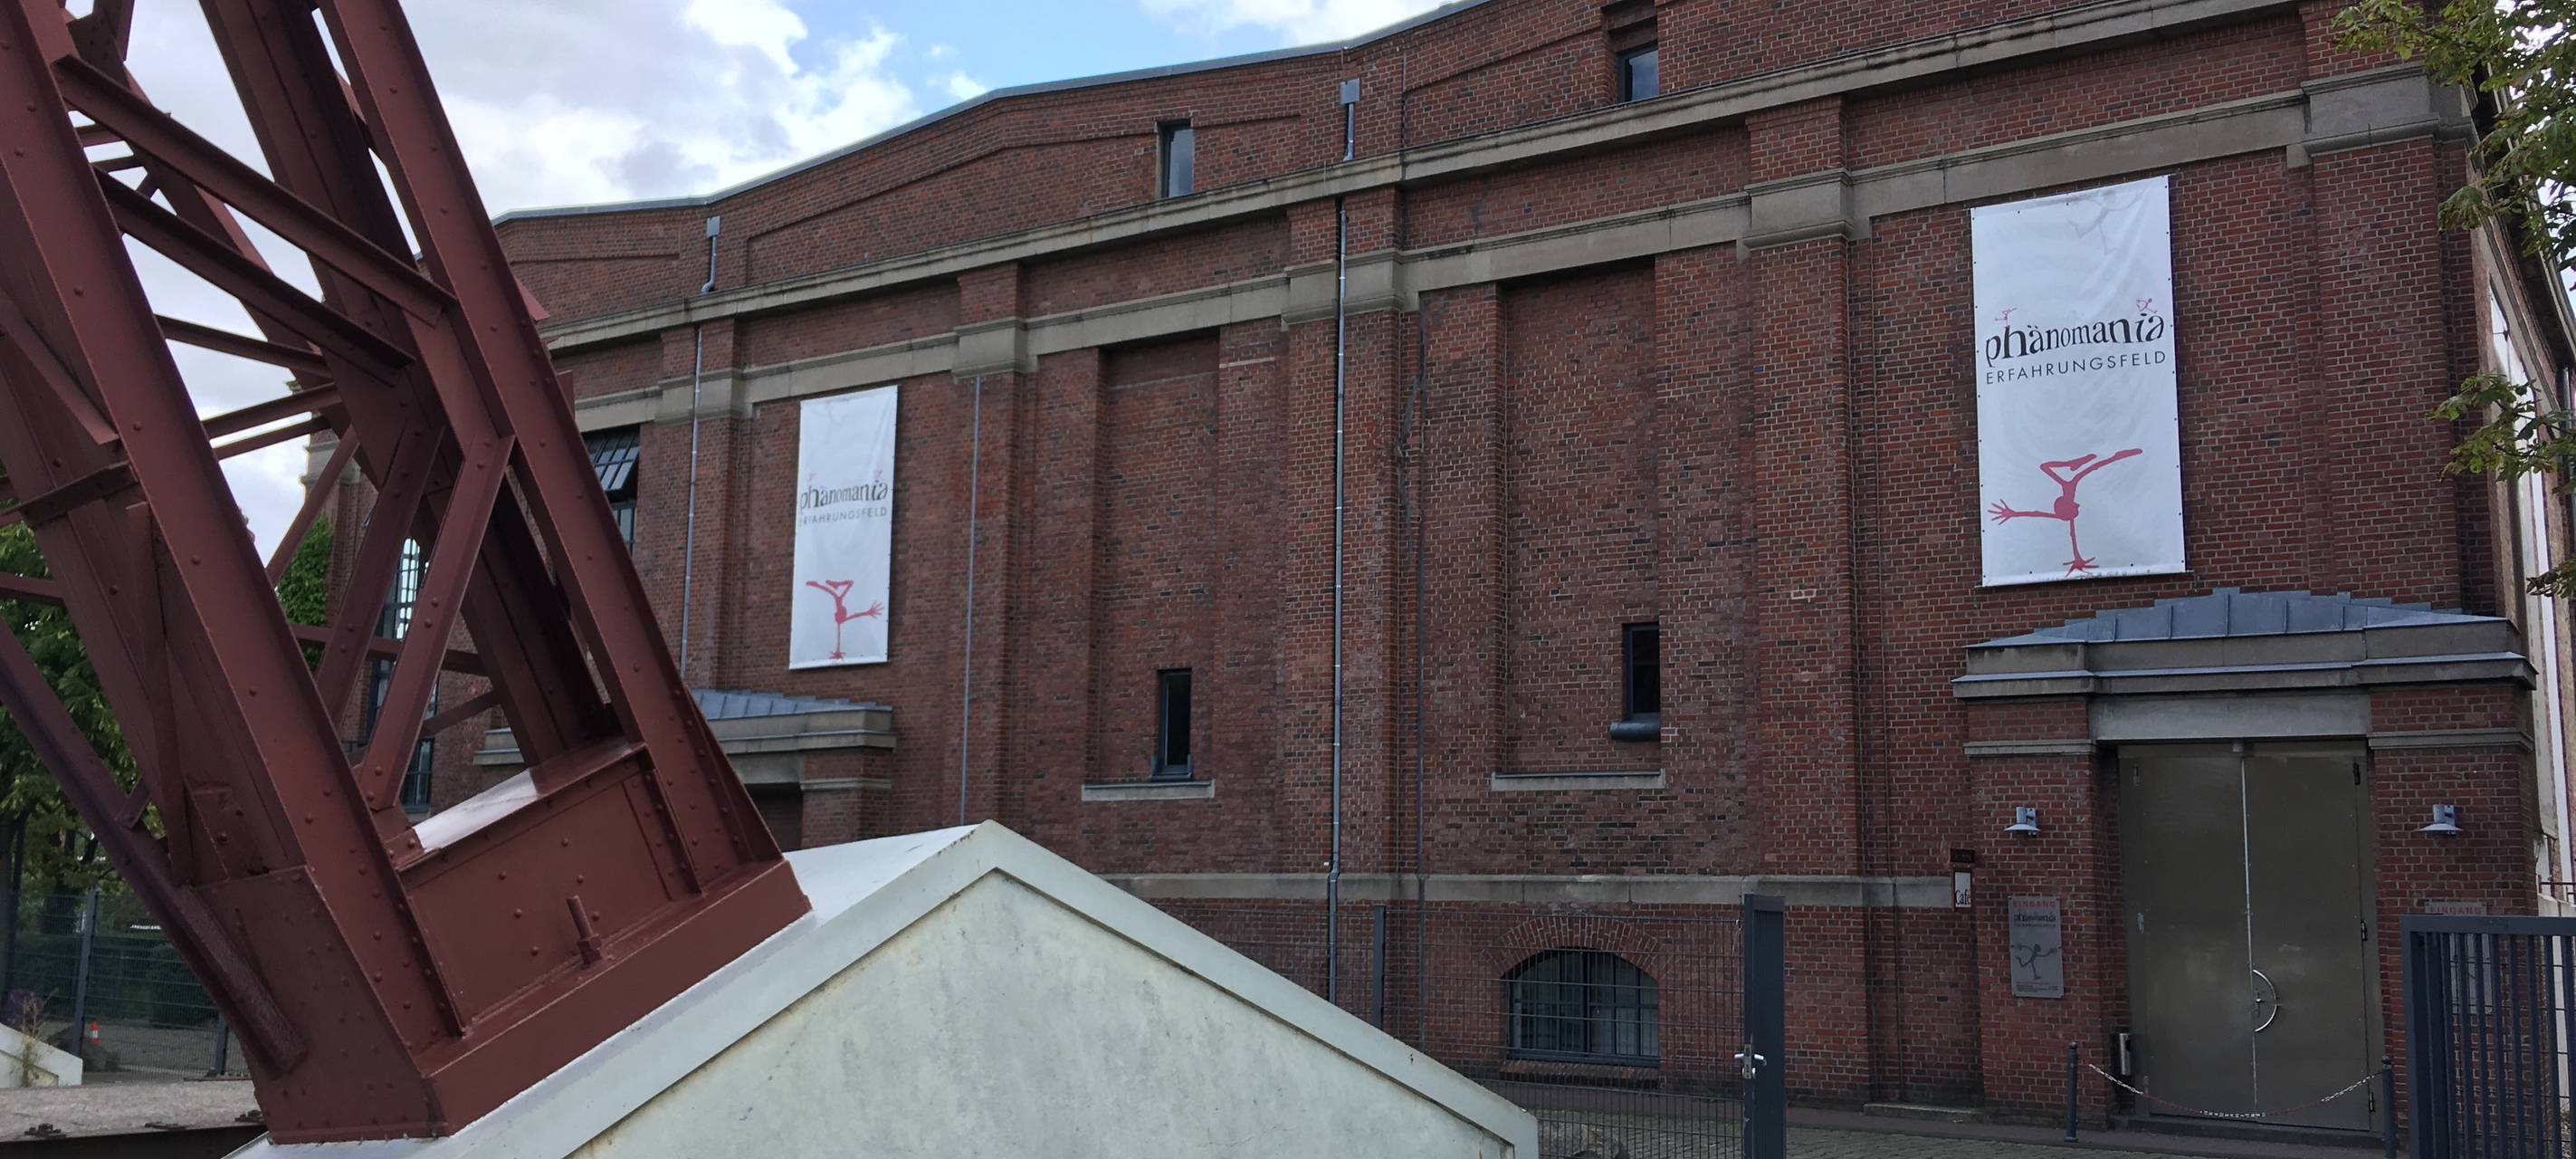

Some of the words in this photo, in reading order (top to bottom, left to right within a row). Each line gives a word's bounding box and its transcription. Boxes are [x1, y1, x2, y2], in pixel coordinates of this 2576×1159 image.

[1986, 312, 2164, 368] phänomania
[1987, 350, 2166, 384] ERFAHRUNGSFELD
[801, 480, 888, 514] phänomania
[798, 507, 887, 525] RAHRUNGSFELD
